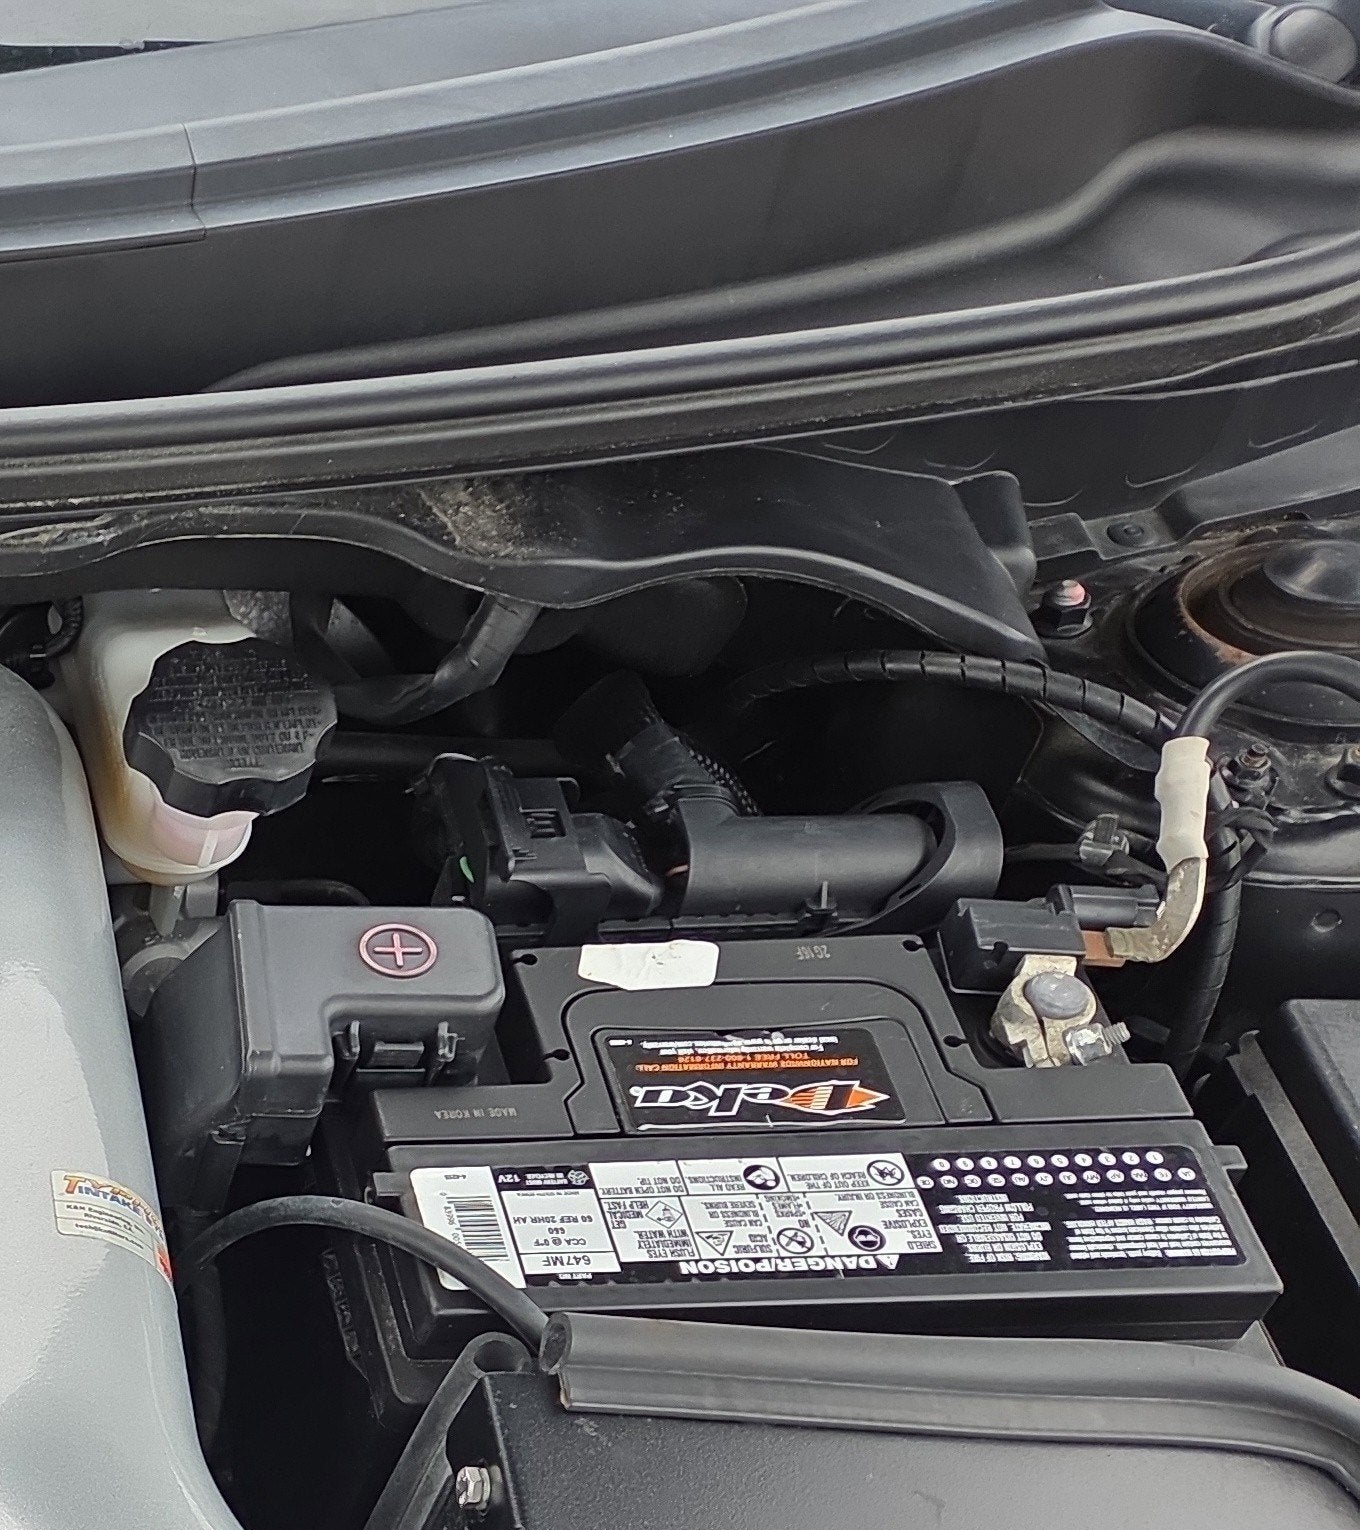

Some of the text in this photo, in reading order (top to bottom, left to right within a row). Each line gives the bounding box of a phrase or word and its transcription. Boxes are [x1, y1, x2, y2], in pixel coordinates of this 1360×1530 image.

[782, 1052, 808, 1060] TOLL
[726, 1060, 778, 1069] WARRANTY
[780, 1058, 839, 1067] NATIONWIDE
[840, 1057, 858, 1066] FOR
[661, 1062, 724, 1071] INFORMATION
[434, 1108, 517, 1120] MADE IN KOREA
[498, 1174, 520, 1183] 12V
[829, 1172, 840, 1180] OF
[842, 1171, 867, 1179] REACH
[655, 1177, 669, 1185] NOT
[805, 1180, 870, 1190] KEEP OUT OF THE
[635, 1186, 654, 1194] OPEN
[656, 1186, 671, 1194] NOT
[672, 1185, 684, 1193] DO
[864, 1192, 875, 1200] OR
[629, 1200, 649, 1209] HELP
[729, 1201, 756, 1209] SEVERE
[879, 1200, 920, 1209] CAN CAUSE
[607, 1211, 644, 1220] MEDICAL
[708, 1210, 759, 1219] BLINDNESS OR
[896, 1208, 923, 1217] GASES
[529, 1216, 557, 1224] 20HR
[559, 1215, 579, 1223] REF
[723, 1219, 747, 1228] CAUSE
[798, 1219, 810, 1228] NO
[611, 1220, 627, 1229] GET
[881, 1219, 928, 1229] EXPLOSIVE
[633, 1229, 689, 1239] WITH WATER.
[748, 1234, 767, 1242] ACID
[907, 1230, 932, 1239] EYES.
[551, 1237, 562, 1246] @
[564, 1238, 586, 1246] CCA
[637, 1239, 692, 1249] IMMEDIATELY
[907, 1241, 937, 1250] SHIELD
[647, 1248, 695, 1258] FLUSH EYES
[733, 1244, 772, 1253] SULFURIC
[541, 1255, 591, 1267] 647MF
[679, 1255, 877, 1274] DANGER/POISON
